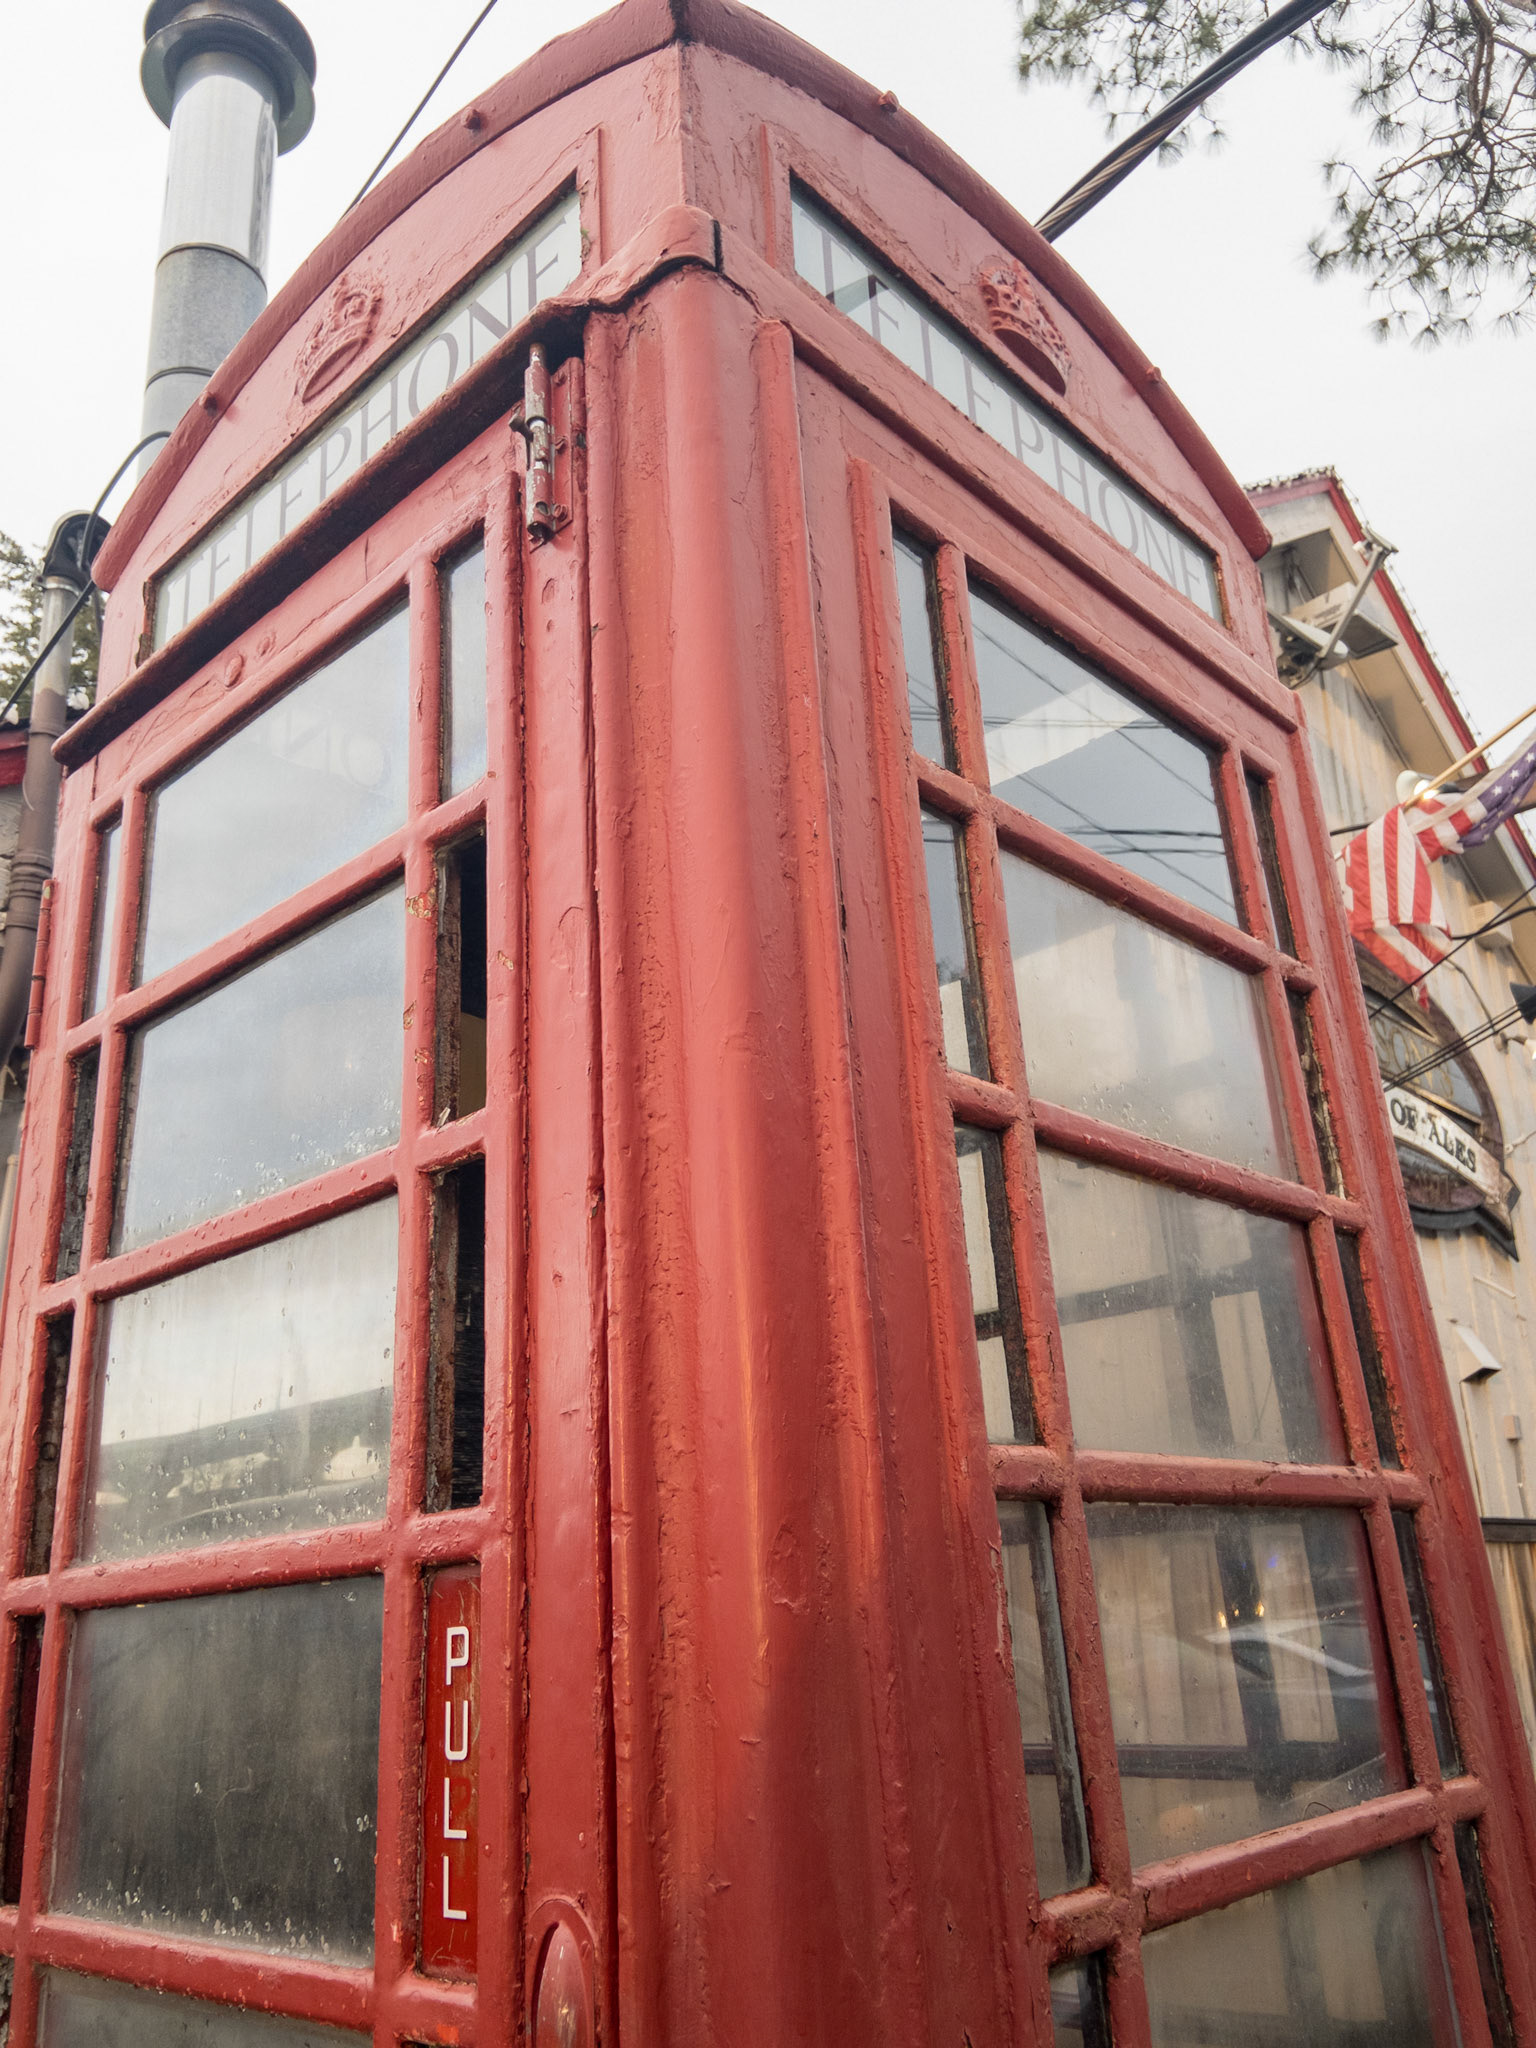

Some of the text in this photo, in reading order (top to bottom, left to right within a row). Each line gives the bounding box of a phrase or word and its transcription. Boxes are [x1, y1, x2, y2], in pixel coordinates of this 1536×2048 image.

[1390, 1098, 1477, 1174] OF ALES
[442, 1626, 470, 1920] PULL
